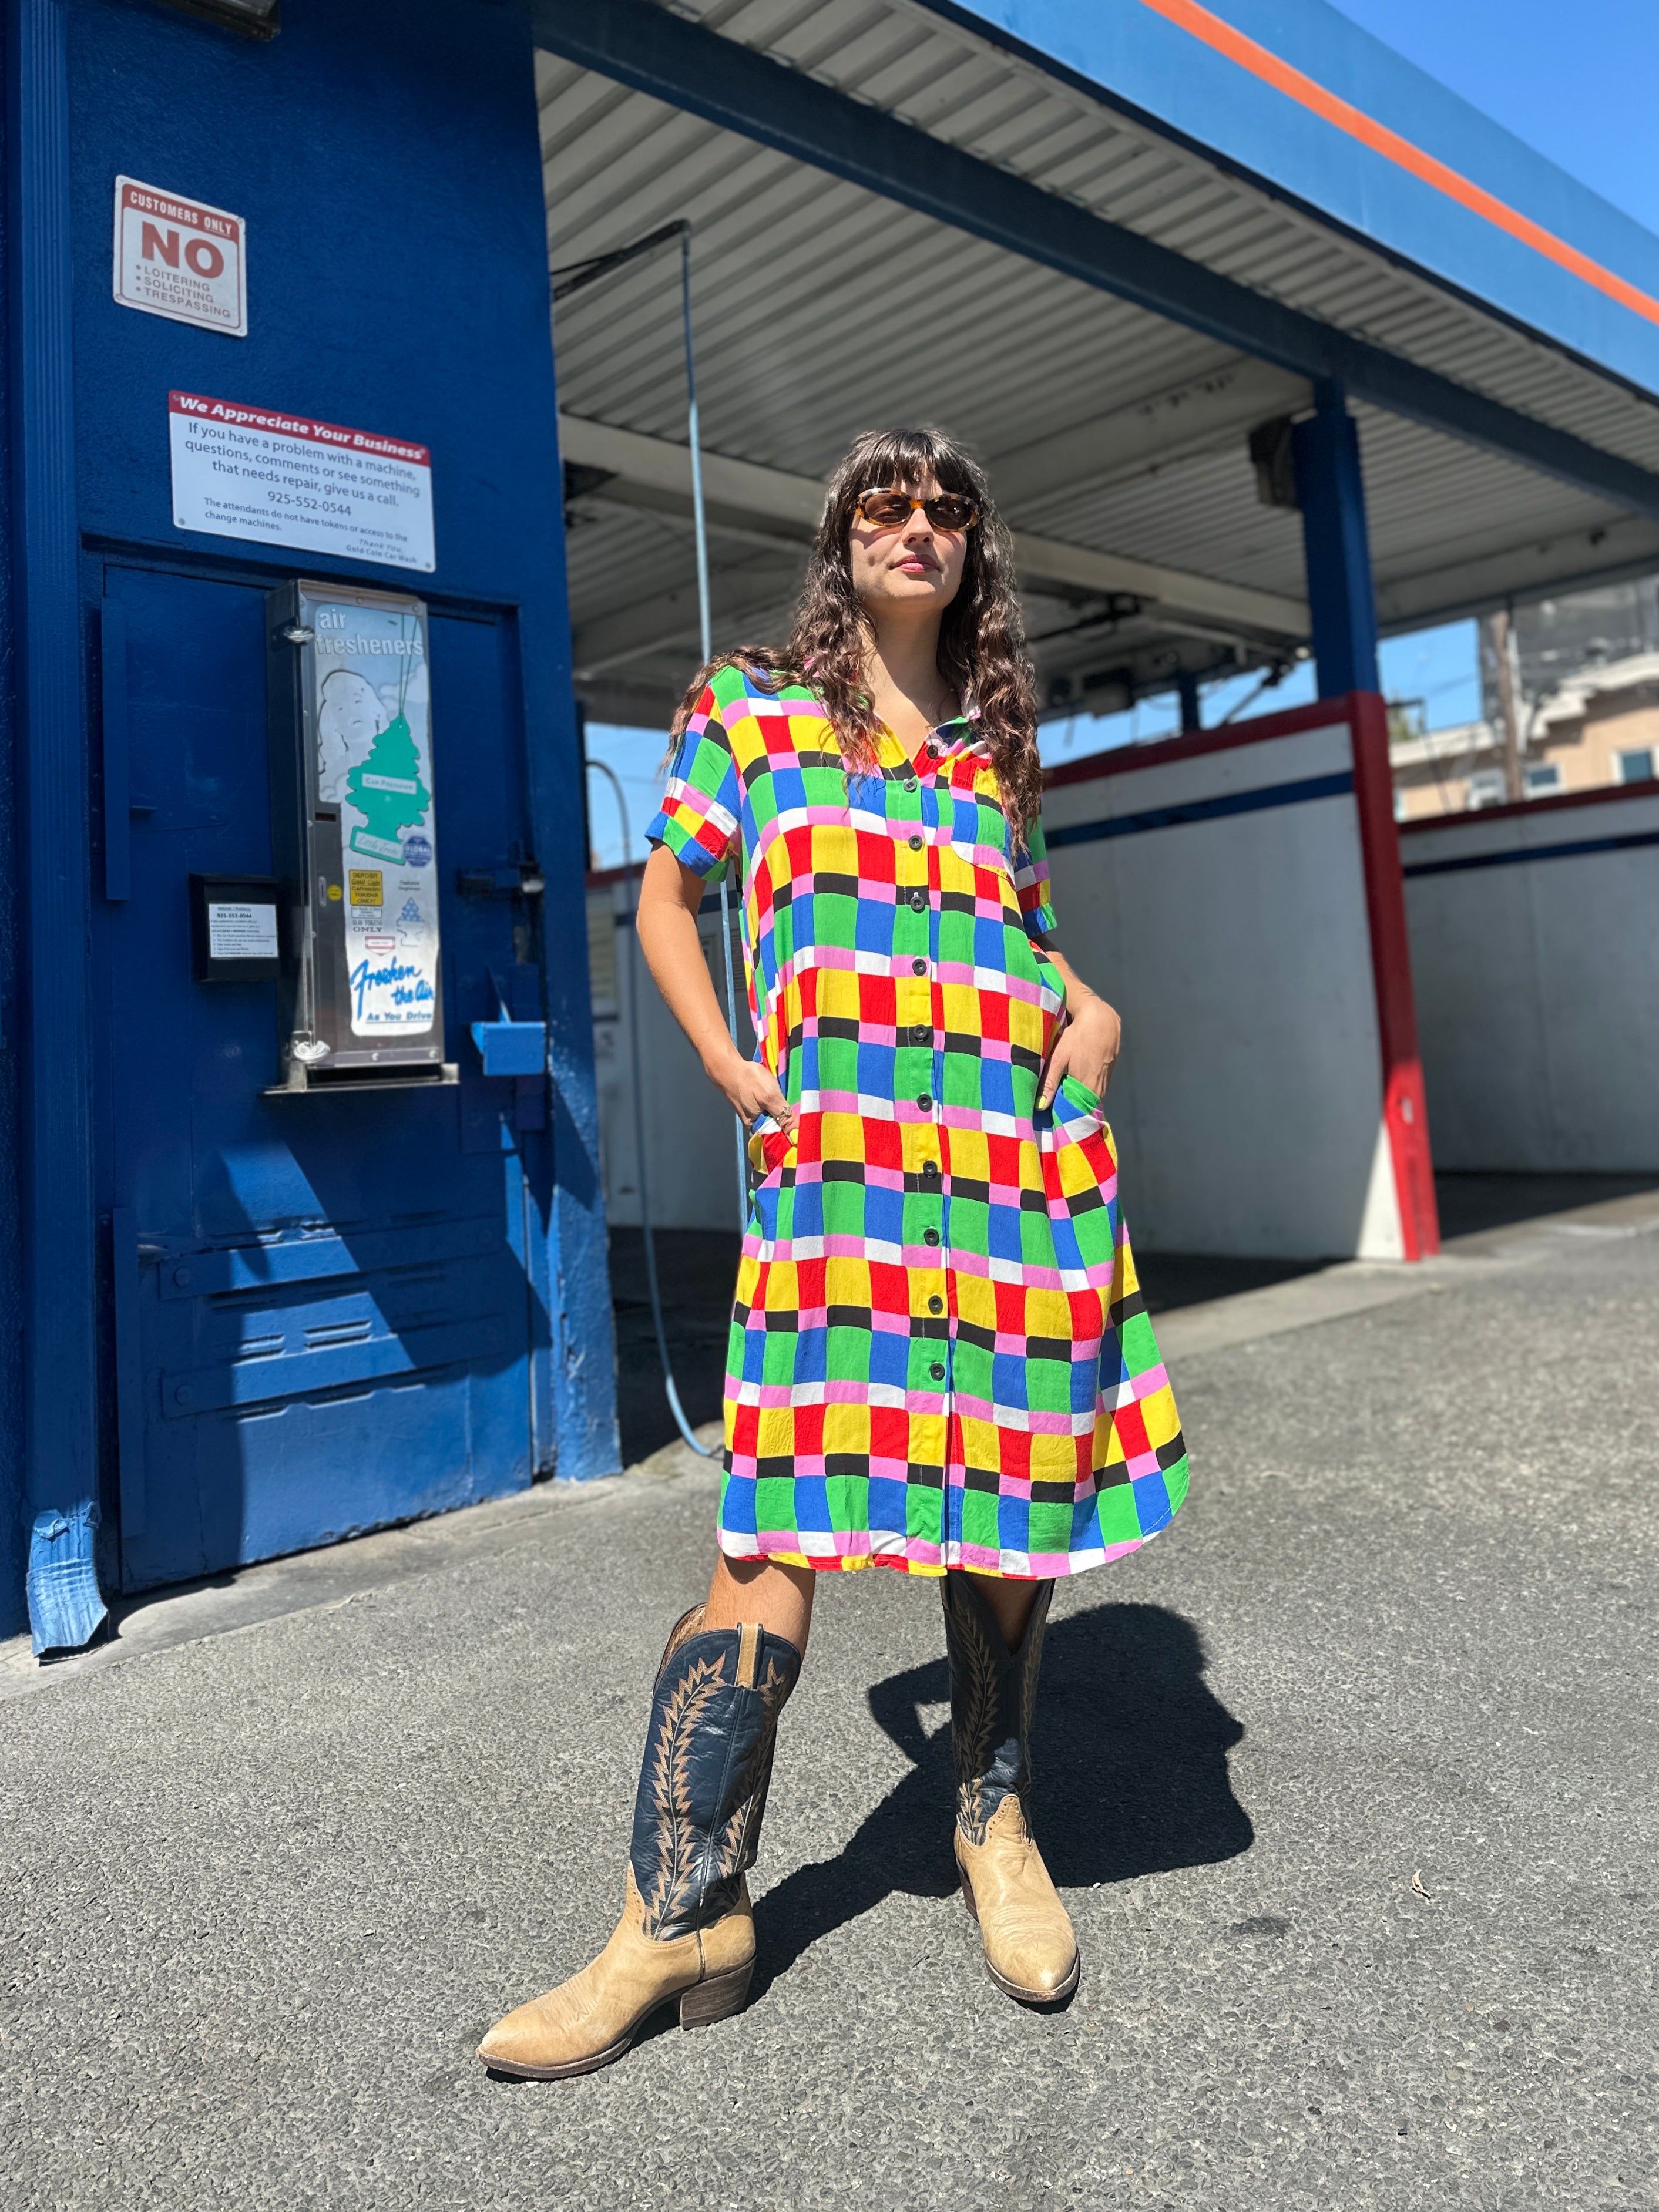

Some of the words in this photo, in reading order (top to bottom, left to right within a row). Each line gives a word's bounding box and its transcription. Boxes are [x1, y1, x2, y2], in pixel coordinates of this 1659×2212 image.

[130, 191, 198, 224] CUSTOMERS
[204, 216, 232, 235] ONLY
[142, 220, 224, 278] NO
[145, 265, 210, 292] LOITERING
[145, 277, 214, 303] SOLICITING
[145, 287, 230, 318] TRESPASSING
[180, 396, 208, 412] We
[211, 404, 309, 434] Appreciate
[313, 425, 351, 443] Your
[354, 435, 422, 460] Business
[189, 422, 198, 434] If
[201, 426, 225, 439] you
[229, 430, 259, 446] have
[262, 440, 268, 448] a
[273, 442, 324, 460] problem
[327, 452, 352, 466] with
[356, 459, 362, 468] a
[365, 461, 416, 481] machine,
[185, 441, 252, 462] questions,
[256, 455, 320, 475] comments
[323, 468, 335, 478] or
[338, 472, 357, 482] see
[360, 475, 420, 498] something
[212, 460, 239, 475] that
[242, 468, 280, 482] needs
[283, 476, 321, 492] repair,
[324, 483, 349, 496] give
[352, 490, 364, 499] us
[368, 493, 374, 501] a
[377, 495, 399, 506] call.
[268, 490, 351, 516] 925-552-0544
[204, 497, 221, 507] The
[223, 502, 269, 516] attendants
[271, 510, 282, 519] do
[284, 513, 298, 522] not
[300, 515, 320, 525] have
[321, 519, 348, 530] tokens
[360, 528, 384, 538] access
[395, 533, 408, 542] the
[205, 510, 237, 524] change
[239, 517, 282, 531] machines.
[346, 544, 364, 553] Gold
[366, 548, 382, 557] Coin
[399, 554, 417, 563] Wash
[360, 539, 384, 549] Thank
[319, 608, 345, 629] air
[315, 634, 423, 655] fresheners
[350, 956, 422, 1021] Freshen
[391, 986, 414, 1006] the
[415, 979, 435, 1001] Air
[367, 1012, 380, 1021] As
[384, 1012, 402, 1020] You
[407, 1011, 432, 1020] Drive
